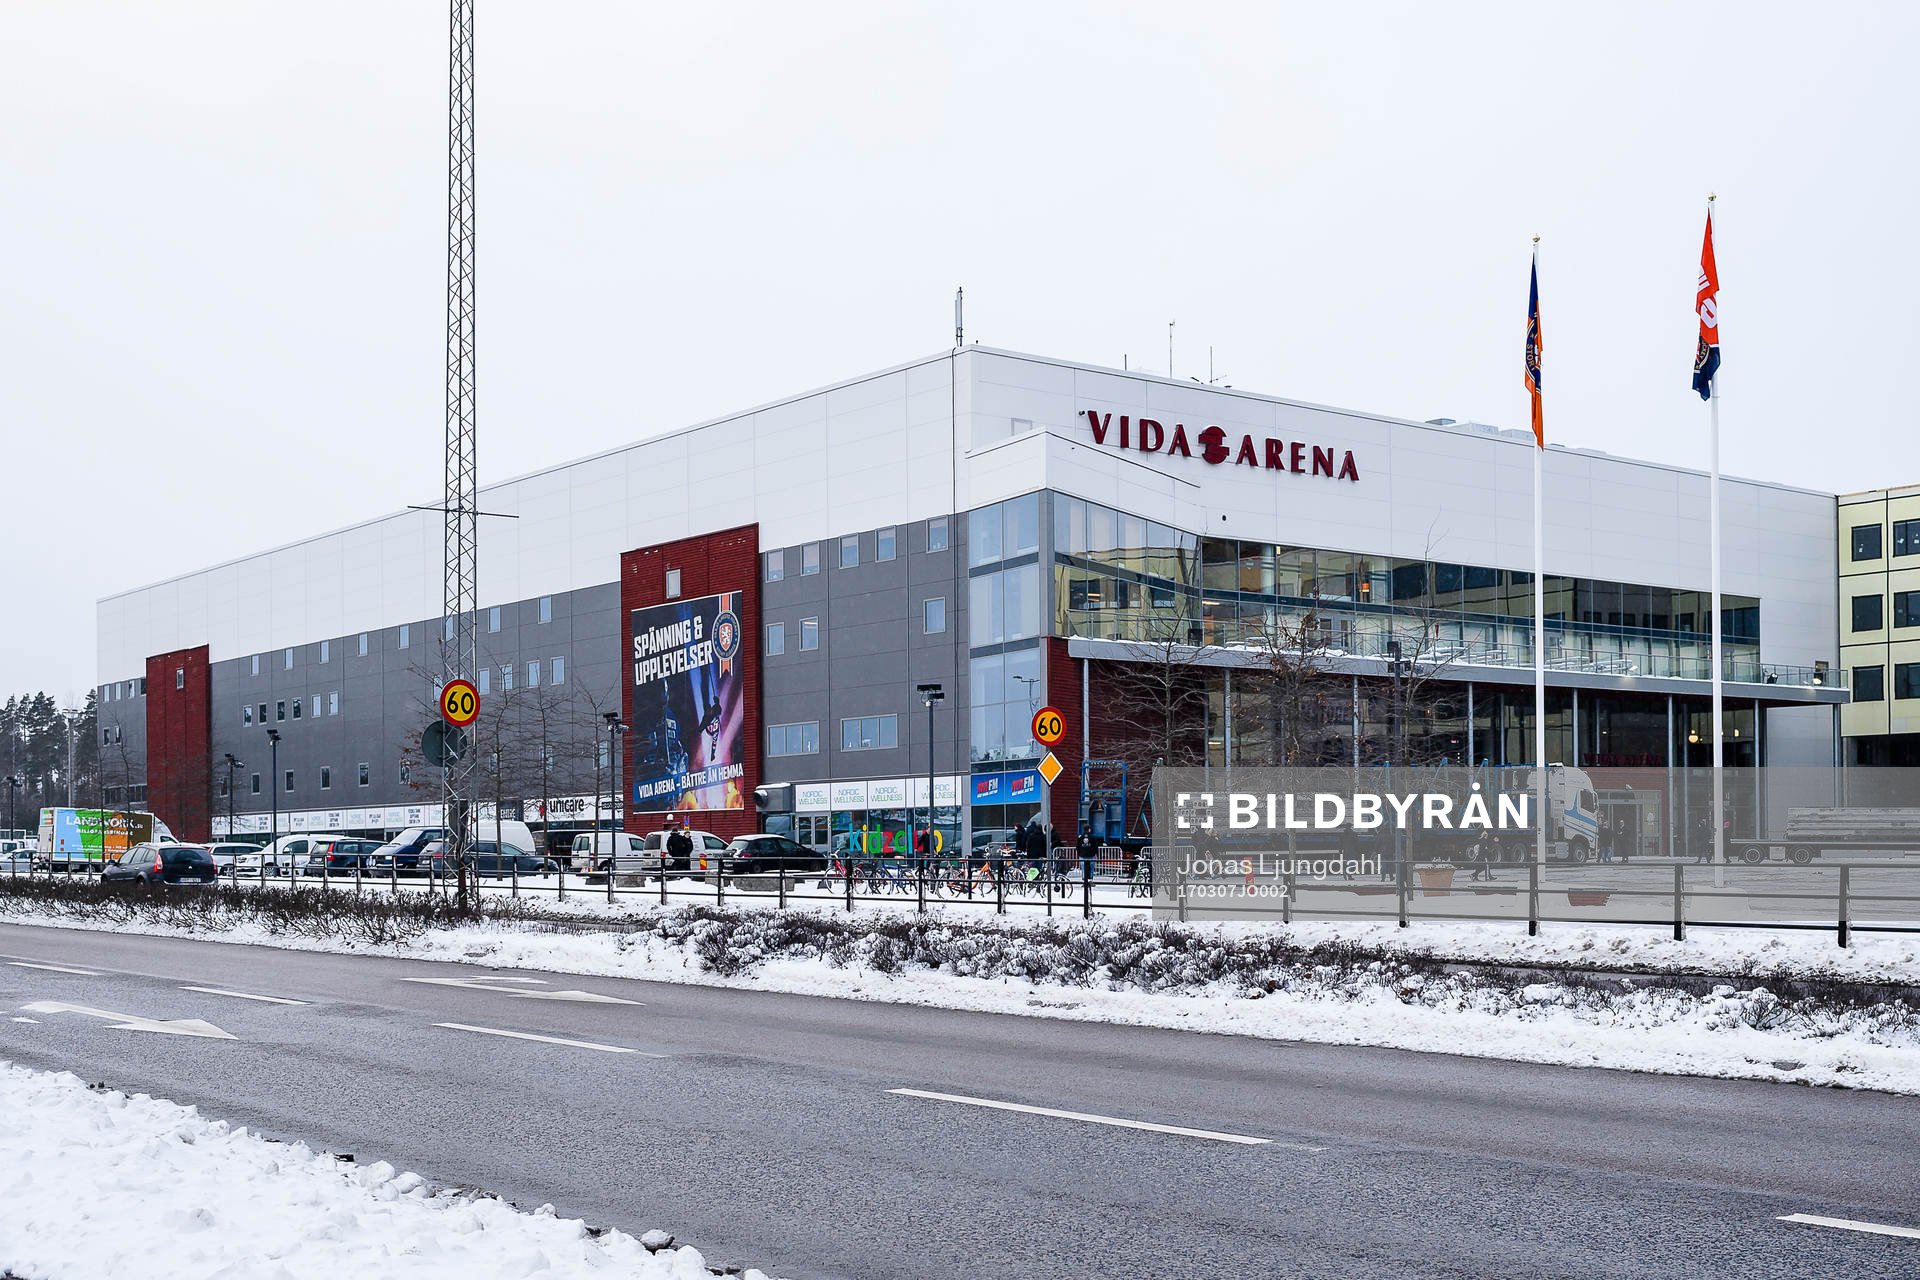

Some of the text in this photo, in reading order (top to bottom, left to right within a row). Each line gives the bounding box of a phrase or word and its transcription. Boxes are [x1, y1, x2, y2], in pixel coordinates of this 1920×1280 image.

[1087, 410, 1360, 481] VIDA ARENA
[634, 619, 692, 659] SPÄNNING
[693, 616, 703, 641] &
[635, 640, 714, 686] UPPLEVELSER
[447, 691, 474, 715] 60
[1037, 717, 1062, 737] 60
[638, 782, 653, 799] VIDA
[654, 777, 676, 794] ARENA
[681, 771, 706, 789] BÄTTRE
[708, 767, 718, 784] ÄN
[719, 763, 744, 781] HEMMA
[875, 786, 897, 794] NORDIC
[926, 783, 950, 791] RDIC
[802, 790, 823, 798] NORDIC
[838, 788, 859, 796] NORDIC
[921, 791, 955, 799] WLNESS
[799, 797, 828, 805] WELLNESS
[834, 795, 865, 803] WELLNESS
[871, 793, 903, 802] WELLNESS
[550, 797, 585, 813] unicare
